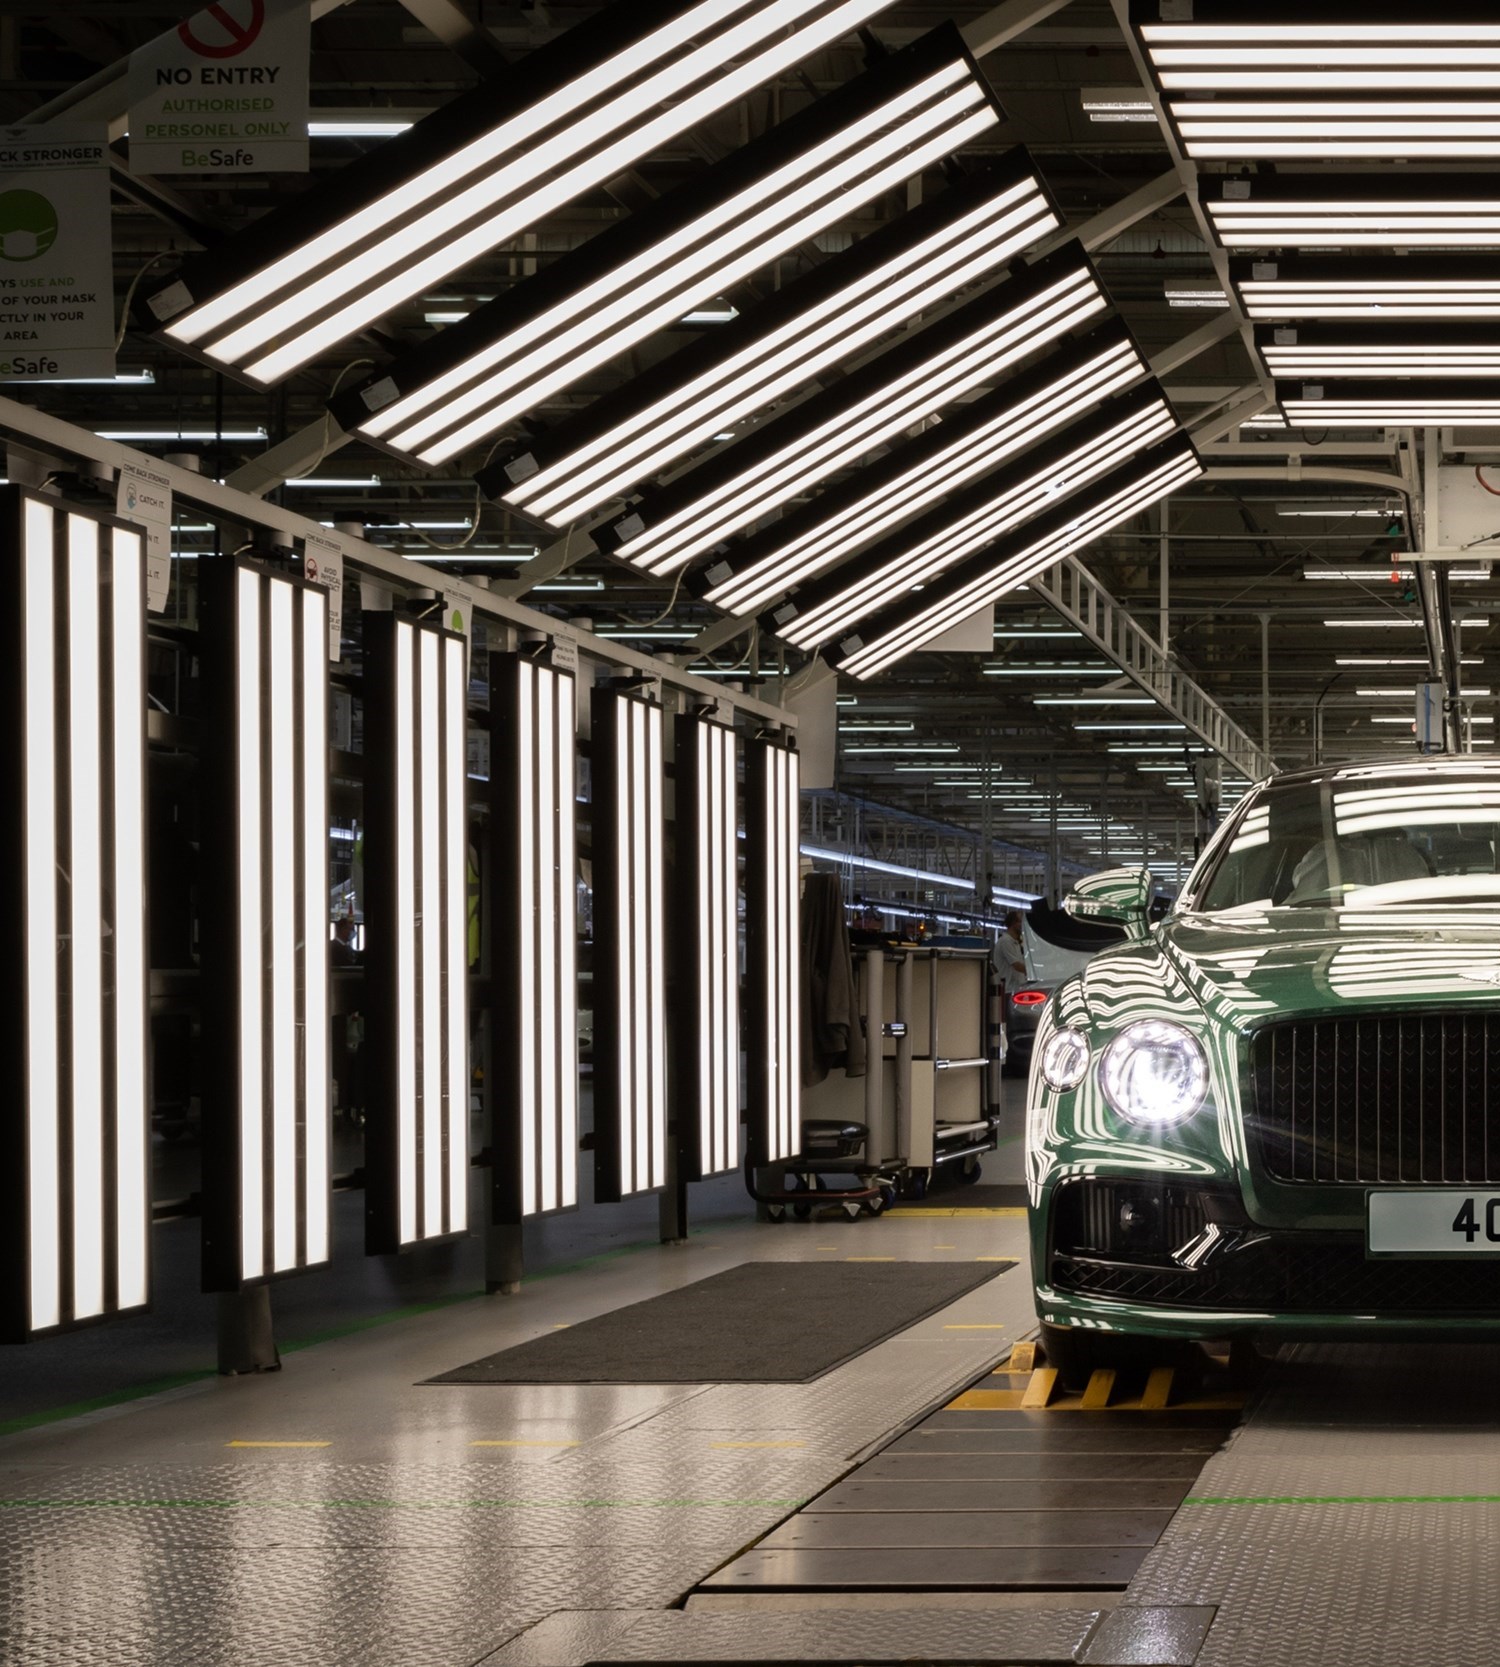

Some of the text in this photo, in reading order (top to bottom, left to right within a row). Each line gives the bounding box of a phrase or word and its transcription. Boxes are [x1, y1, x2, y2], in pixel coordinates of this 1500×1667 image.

[157, 66, 281, 86] NO ENTRY
[162, 97, 274, 113] AUTHORISED
[145, 121, 291, 138] PERSONEL ONLY
[0, 147, 103, 162] CK STRONGER
[181, 149, 254, 168] BeSafe
[20, 278, 45, 289] USE
[48, 277, 76, 288] AND
[1, 293, 97, 306] OF YOUR MASK
[33, 313, 46, 322] IN
[50, 311, 84, 321] YOUR
[3, 331, 39, 341] AREA
[0, 356, 59, 375] eSafe
[139, 494, 157, 507] CATCH
